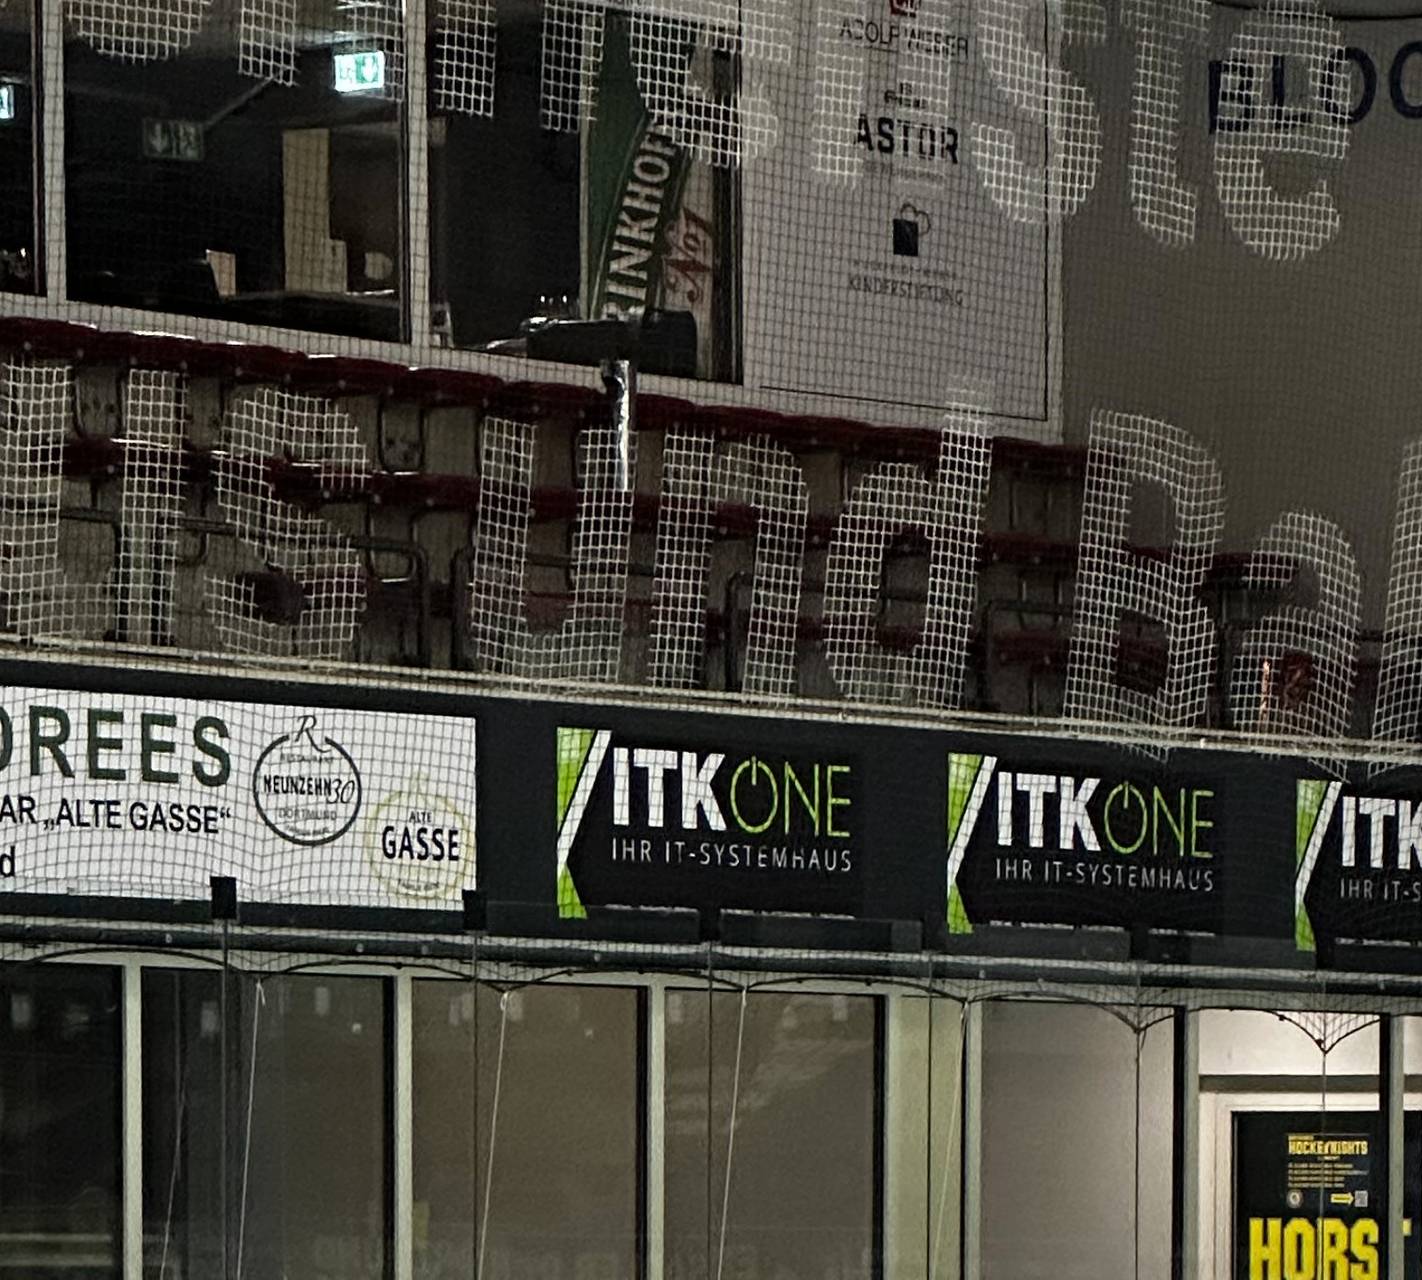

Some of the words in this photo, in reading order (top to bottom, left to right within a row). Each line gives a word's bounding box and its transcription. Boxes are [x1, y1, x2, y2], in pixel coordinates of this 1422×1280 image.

[853, 113, 958, 164] ASTOR
[409, 811, 433, 824] ALTE
[382, 825, 460, 862] GASSE
[612, 837, 652, 862] IHR
[665, 840, 851, 873] IT-SYSTEMHAUS
[996, 857, 1032, 881] IHR
[1045, 860, 1213, 893] IT-SYSTEMHAUS
[1340, 877, 1373, 899] IHR
[1249, 1217, 1412, 1280] HORS
